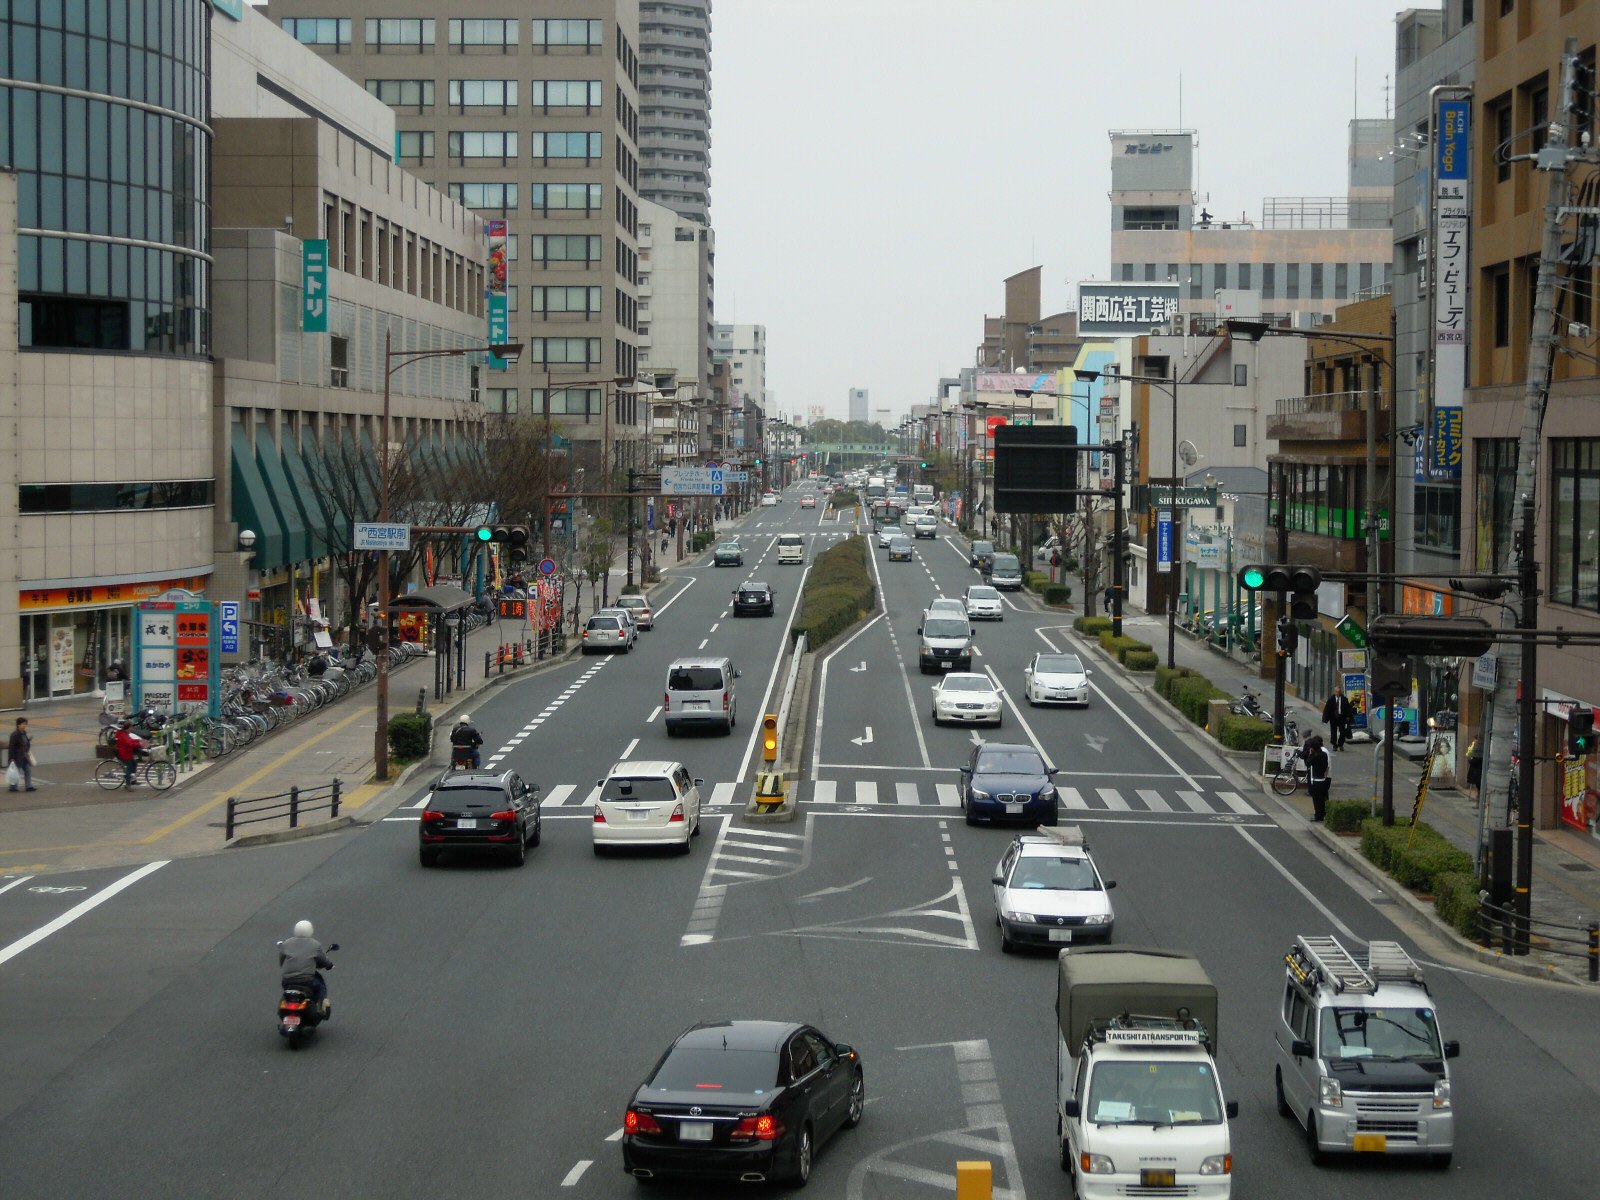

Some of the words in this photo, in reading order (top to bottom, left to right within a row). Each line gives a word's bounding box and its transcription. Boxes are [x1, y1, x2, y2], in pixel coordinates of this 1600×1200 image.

[1446, 111, 1456, 140] Brain
[1442, 142, 1456, 171] Yoga
[307, 253, 322, 318] ニトリ
[1438, 230, 1463, 329] エフ・ビューティ
[1437, 333, 1463, 341] 西宮店
[1437, 410, 1446, 466] ネットカフェ
[1449, 410, 1461, 466] コミック
[224, 608, 235, 619] P
